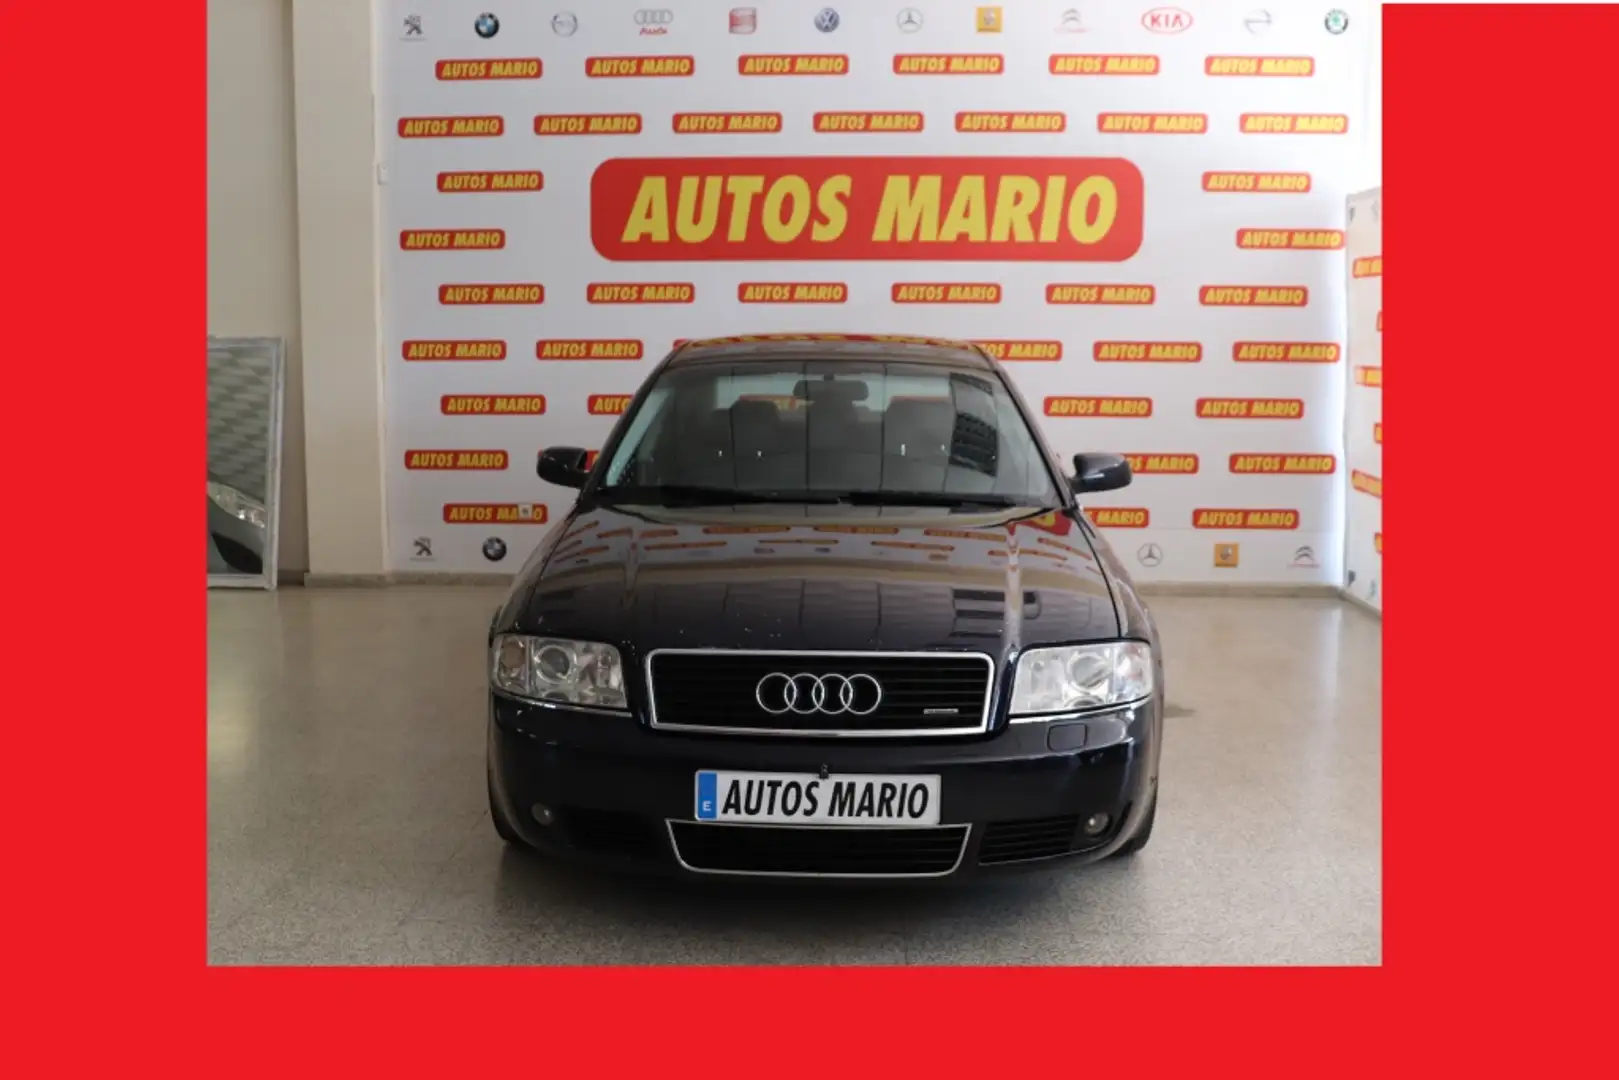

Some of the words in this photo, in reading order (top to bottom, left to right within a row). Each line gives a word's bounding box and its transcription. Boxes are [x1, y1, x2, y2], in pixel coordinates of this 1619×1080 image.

[1149, 13, 1184, 28] KIA
[442, 63, 487, 78] AUTOS
[489, 62, 538, 76] MARIO
[592, 60, 638, 74] AUTOS
[640, 60, 690, 74] MARIO
[745, 57, 792, 73] AUTOS
[794, 58, 845, 72] MARIO
[900, 57, 947, 71] AUTOS
[949, 57, 1000, 71] MARIO
[1055, 57, 1102, 71] AUTOS
[1104, 58, 1155, 72] MARIO
[1211, 57, 1258, 73] AUTOS
[1260, 59, 1311, 74] MARIO
[405, 120, 449, 134] AUTOS
[451, 119, 499, 134] MARIO
[540, 117, 586, 132] AUTOS
[588, 117, 638, 131] MARIO
[679, 116, 725, 130] AUTOS
[728, 116, 778, 130] MARIO
[820, 115, 867, 130] AUTOS
[869, 115, 920, 129] MARIO
[961, 115, 1008, 130] AUTOS
[1011, 116, 1062, 130] MARIO
[1104, 116, 1150, 130] AUTOS
[1153, 116, 1203, 131] MARIO
[1246, 116, 1292, 131] AUTOS
[1295, 117, 1345, 131] MARIO
[443, 174, 487, 189] AUTOS
[490, 174, 538, 188] MARIO
[1208, 175, 1255, 189] AUTOS
[1257, 176, 1308, 190] MARIO
[622, 175, 852, 244] AUTOS
[873, 174, 1117, 244] MARIO
[407, 234, 450, 246] AUTOS
[453, 233, 500, 246] MARIO
[1243, 231, 1289, 246] AUTOS
[1292, 232, 1342, 246] MARIO
[444, 287, 489, 302] AUTOS
[491, 287, 540, 302] MARIO
[593, 286, 639, 301] AUTOS
[641, 287, 691, 300] MARIO
[744, 285, 790, 300] AUTOS
[792, 286, 842, 300] MARIO
[897, 286, 944, 300] AUTOS
[947, 286, 998, 300] MARIO
[1052, 287, 1099, 301] AUTOS
[1101, 287, 1152, 303] MARIO
[1206, 288, 1252, 303] AUTOS
[1254, 289, 1304, 303] MARIO
[408, 343, 451, 358] AUTOS
[454, 343, 501, 357] MARIO
[542, 342, 587, 357] AUTOS
[589, 342, 638, 356] MARIO
[1007, 343, 1059, 358] MARIO
[1100, 345, 1146, 358] AUTOS
[1149, 345, 1199, 359] MARIO
[1239, 345, 1284, 359] AUTOS
[1287, 345, 1336, 359] MARIO
[446, 398, 491, 412] AUTOS
[494, 398, 543, 412] MARIO
[1050, 399, 1096, 415] AUTOS
[1098, 400, 1148, 415] MARIO
[1202, 401, 1248, 414] AUTOS
[1250, 402, 1300, 416] MARIO
[412, 453, 455, 466] AUTOS
[458, 453, 505, 467] MARIO
[1145, 456, 1195, 471] MARIO
[1236, 457, 1281, 470] AUTOS
[1283, 457, 1332, 471] MARIO
[449, 506, 493, 521] AUTOS
[496, 507, 544, 521] MAO
[1096, 510, 1146, 526] MARIO
[1198, 511, 1244, 526] AUTOS
[1246, 513, 1296, 526] MARIO
[702, 800, 712, 812] E
[721, 779, 820, 816] AUTOS
[828, 782, 930, 819] MARIO
